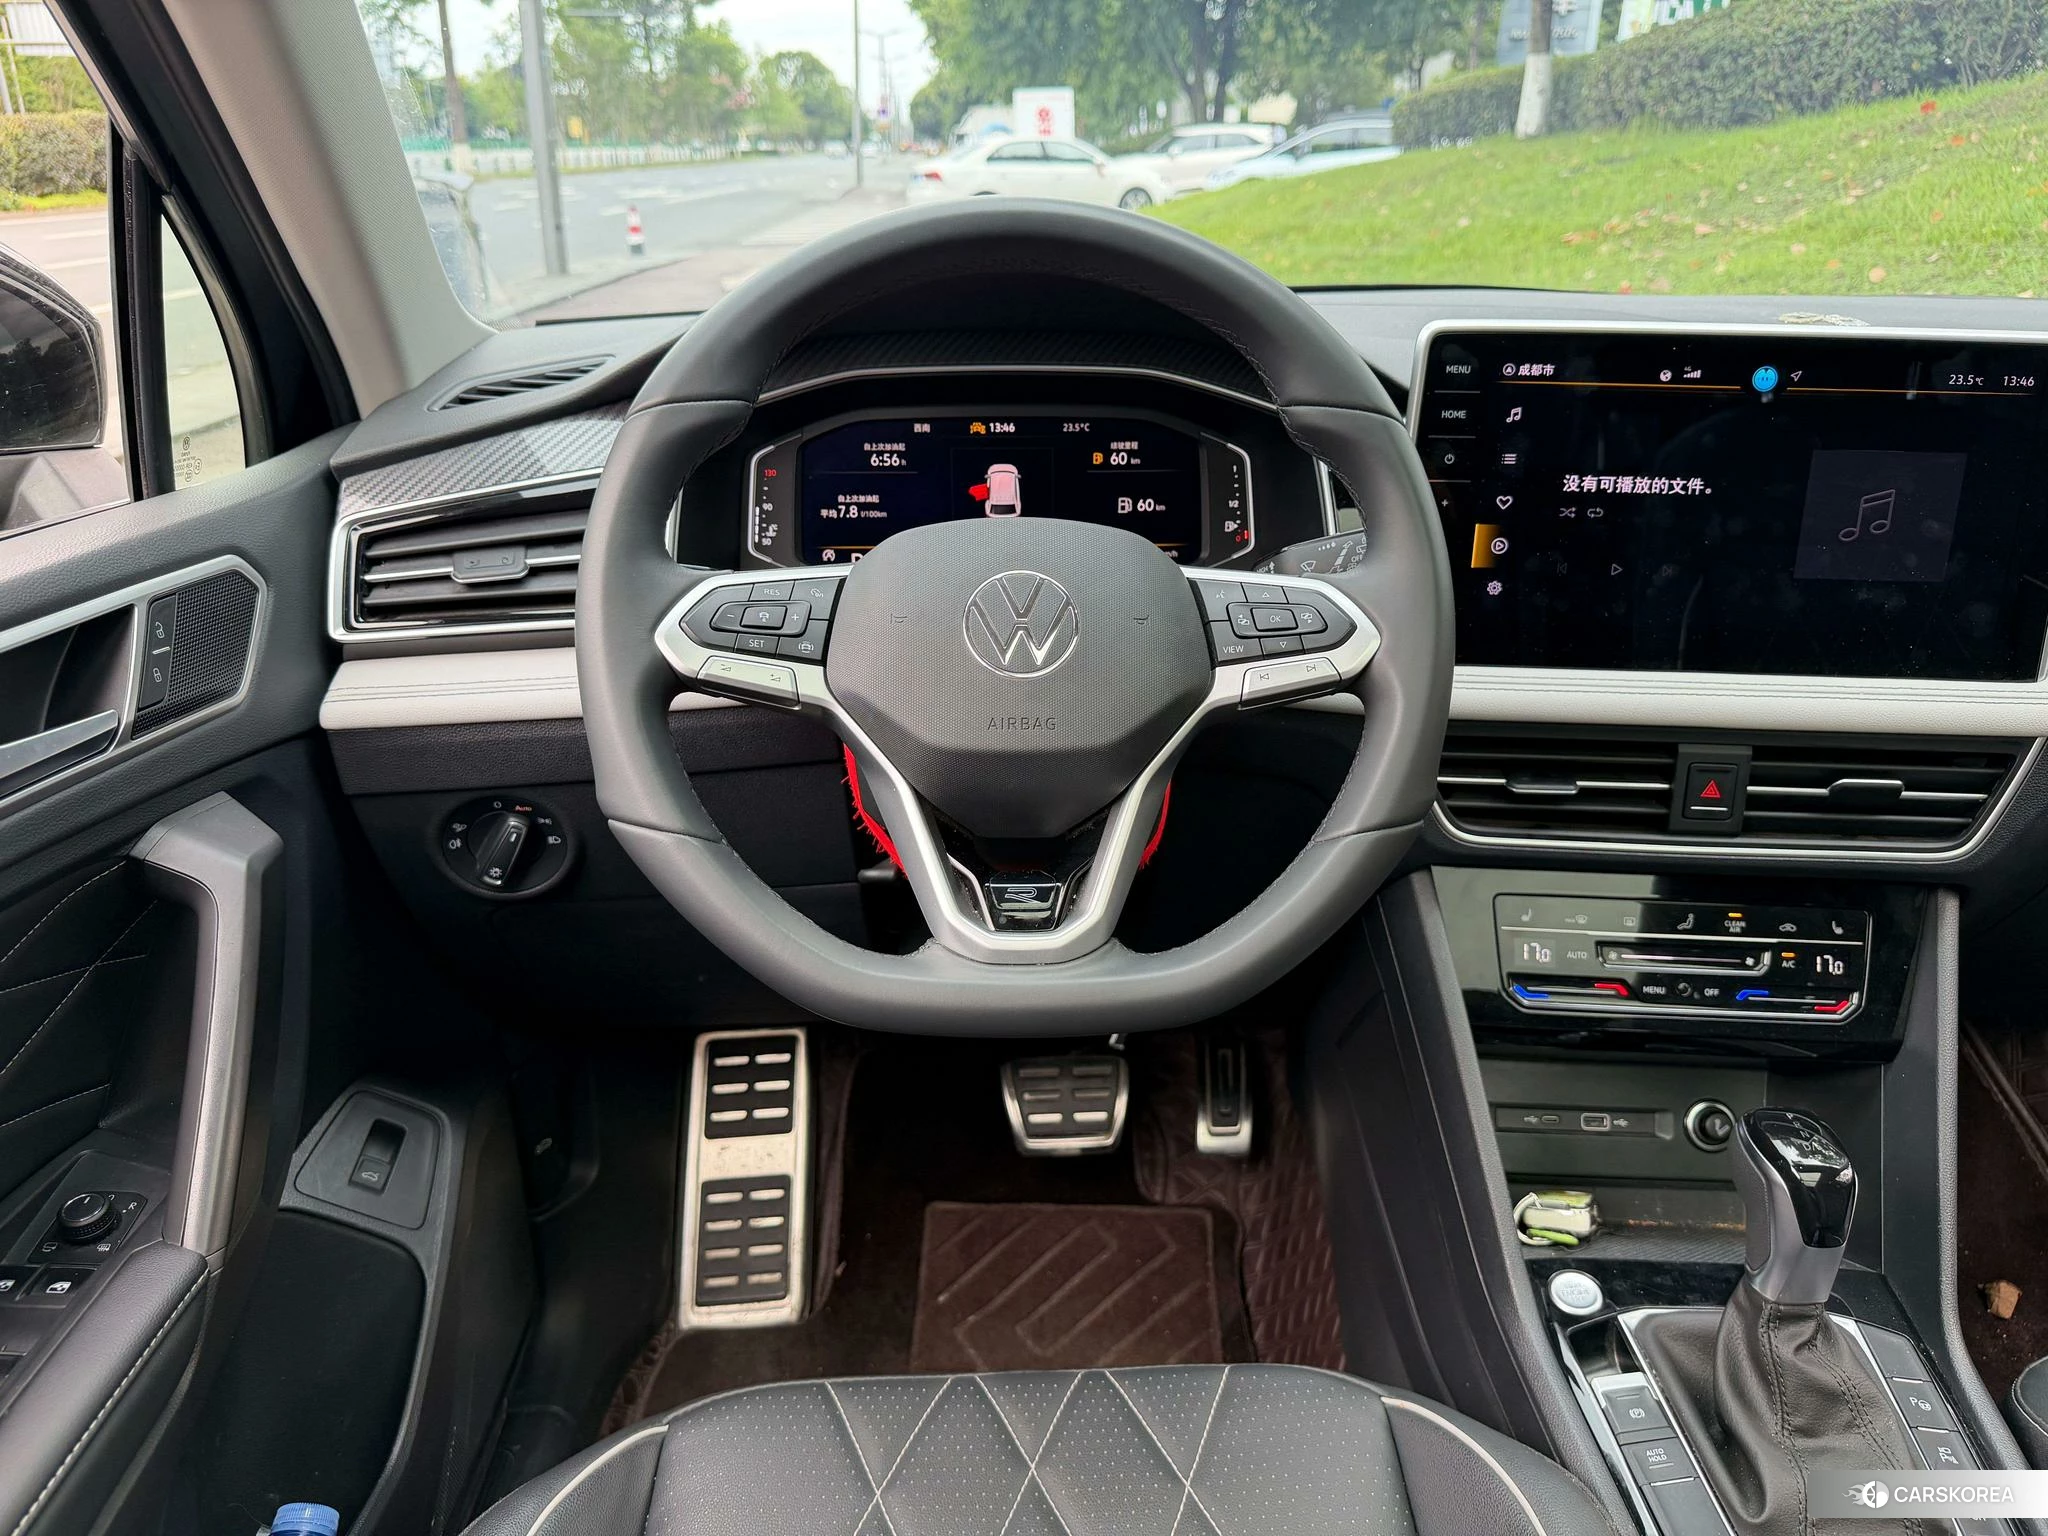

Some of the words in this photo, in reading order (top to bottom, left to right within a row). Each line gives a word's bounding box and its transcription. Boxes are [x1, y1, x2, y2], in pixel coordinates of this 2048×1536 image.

[1446, 365, 1471, 374] MENU
[1518, 363, 1555, 376] 成都市
[2003, 376, 2035, 387] 13:46
[1441, 410, 1466, 419] HOME
[989, 422, 1015, 433] 13:46
[870, 453, 900, 467] 6:56
[1110, 452, 1128, 465] 60
[764, 469, 777, 477] 130
[1562, 474, 1712, 495] 没有可播放的文件。
[1137, 498, 1155, 512] 60
[837, 505, 859, 518] 7.8
[763, 588, 781, 596] RES
[1270, 615, 1281, 623] OK
[749, 639, 765, 648] SET
[1222, 645, 1245, 654] VIEW
[987, 717, 1056, 731] AIRBAG
[1724, 920, 1746, 928] CLEAN
[1566, 951, 1588, 960] AUTO
[1781, 961, 1796, 969] A/C
[1642, 986, 1666, 995] MENU
[1704, 988, 1720, 997] OFF
[1646, 1448, 1664, 1456] AUTO
[1648, 1454, 1667, 1462] HOLD
